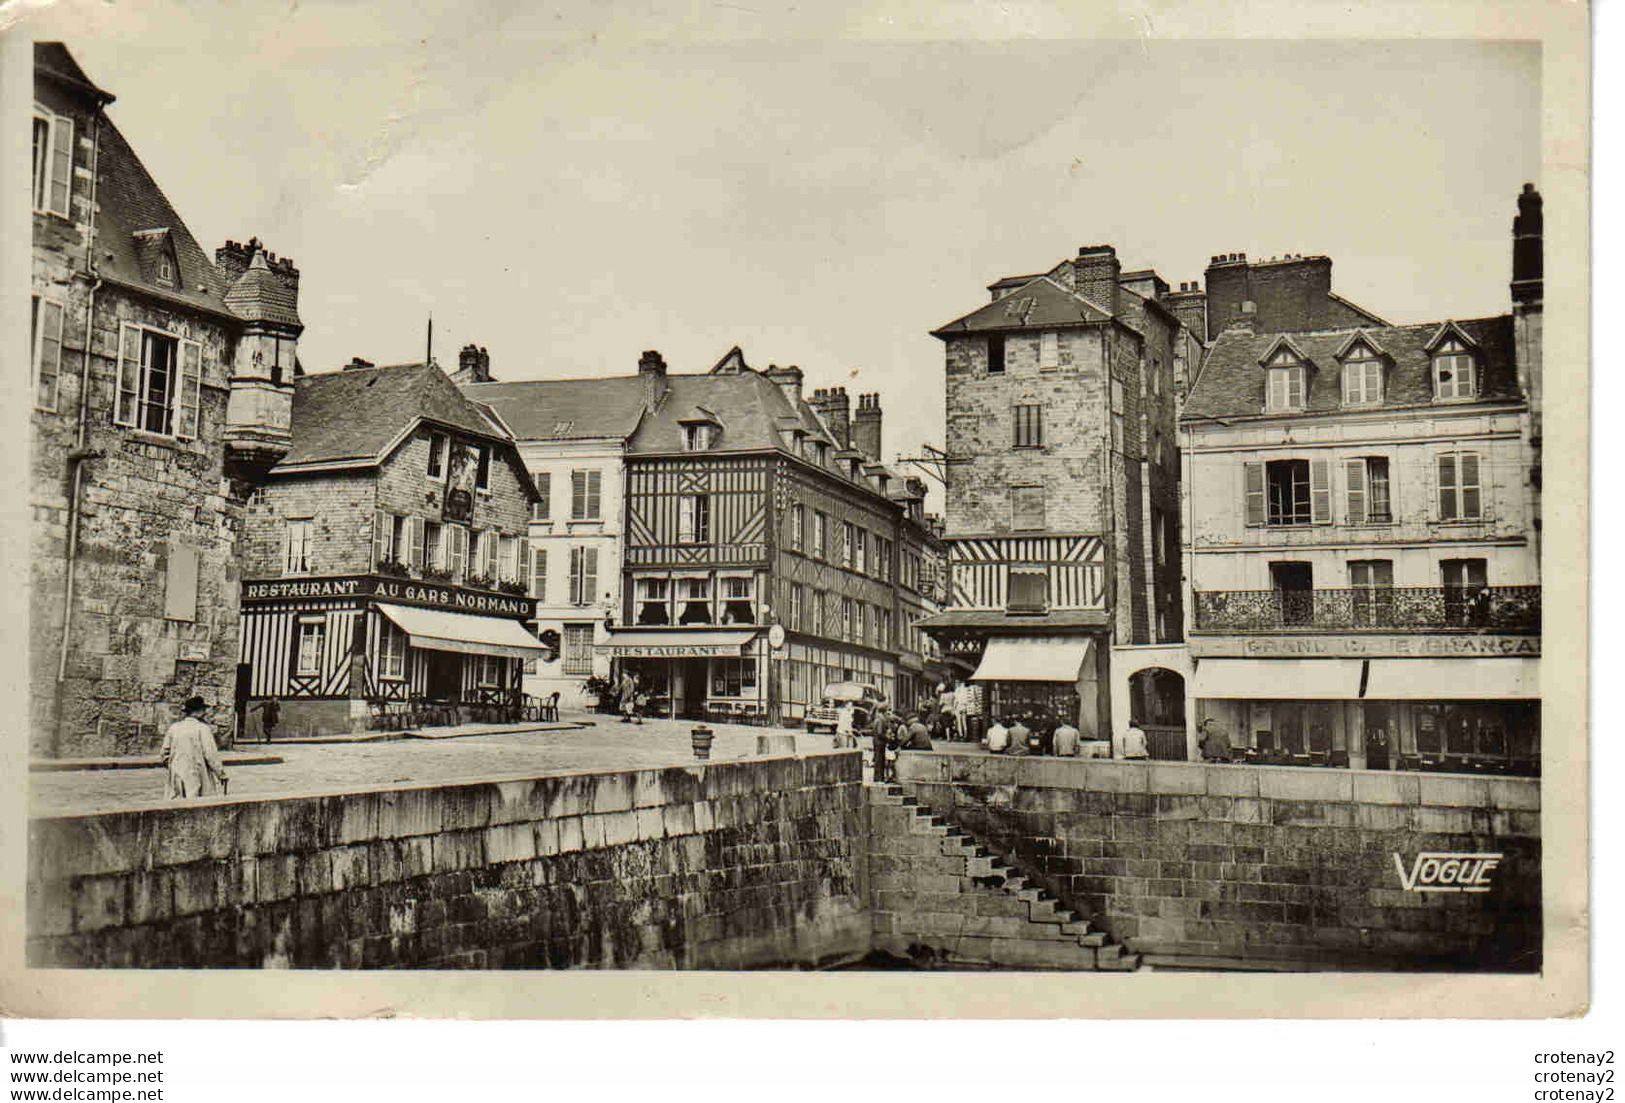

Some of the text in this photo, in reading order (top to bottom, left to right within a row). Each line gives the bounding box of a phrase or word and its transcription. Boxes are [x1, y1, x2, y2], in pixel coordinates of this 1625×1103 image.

[248, 580, 530, 614] RESTAURANT AU GARS NORMAND
[613, 646, 719, 656] RESTAURANT
